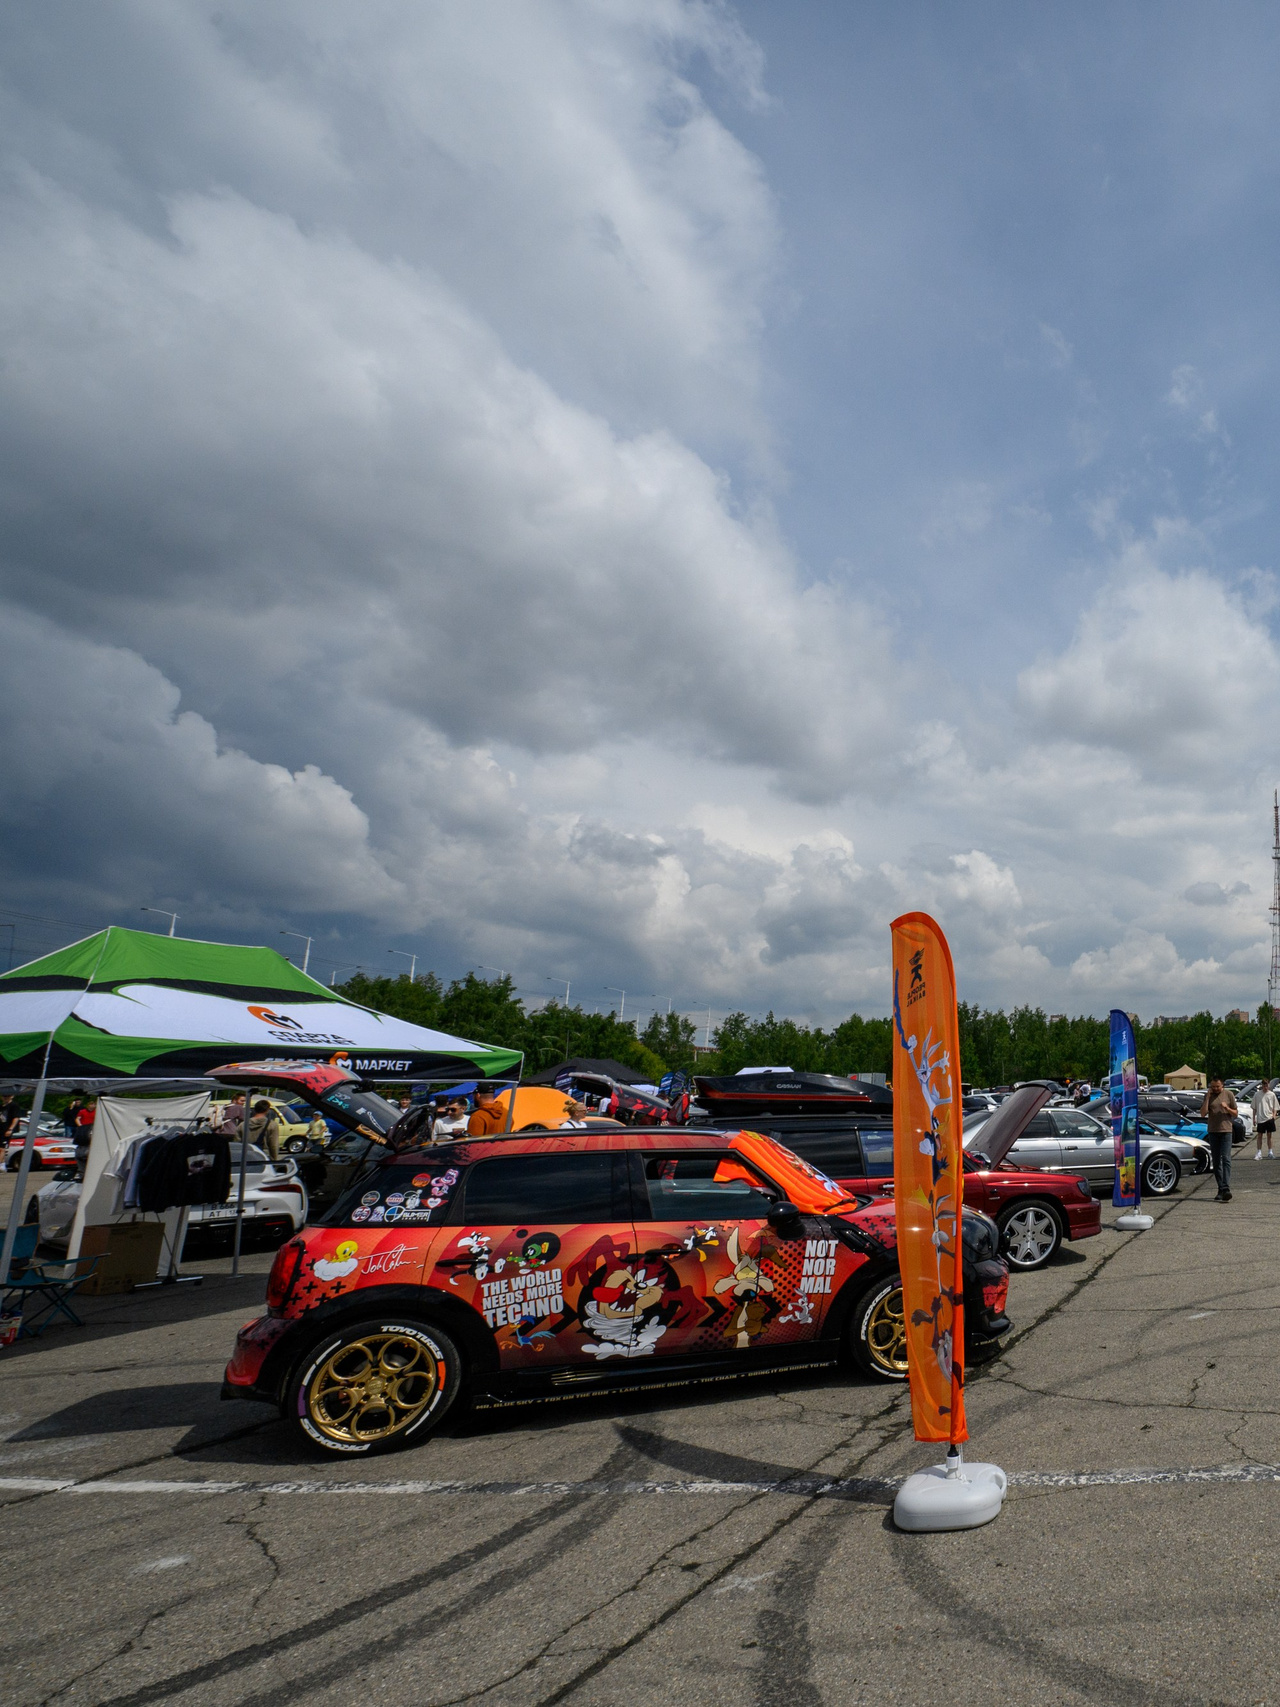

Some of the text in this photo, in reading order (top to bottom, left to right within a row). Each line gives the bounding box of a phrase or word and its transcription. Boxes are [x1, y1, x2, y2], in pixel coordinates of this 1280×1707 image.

[268, 1030, 346, 1040] СПАРТА
[277, 1037, 357, 1046] МАРКЕТ
[355, 1060, 412, 1071] МАРКЕТ
[804, 1239, 838, 1258] NOT
[802, 1258, 836, 1275] NOR
[481, 1268, 562, 1297] THE WORLD
[800, 1276, 832, 1294] MAL
[482, 1281, 563, 1310] NEEDS MORE
[482, 1294, 564, 1328] TECHNO
[380, 1325, 444, 1360] TOYO TIRES
[300, 1418, 371, 1451] PROXES
